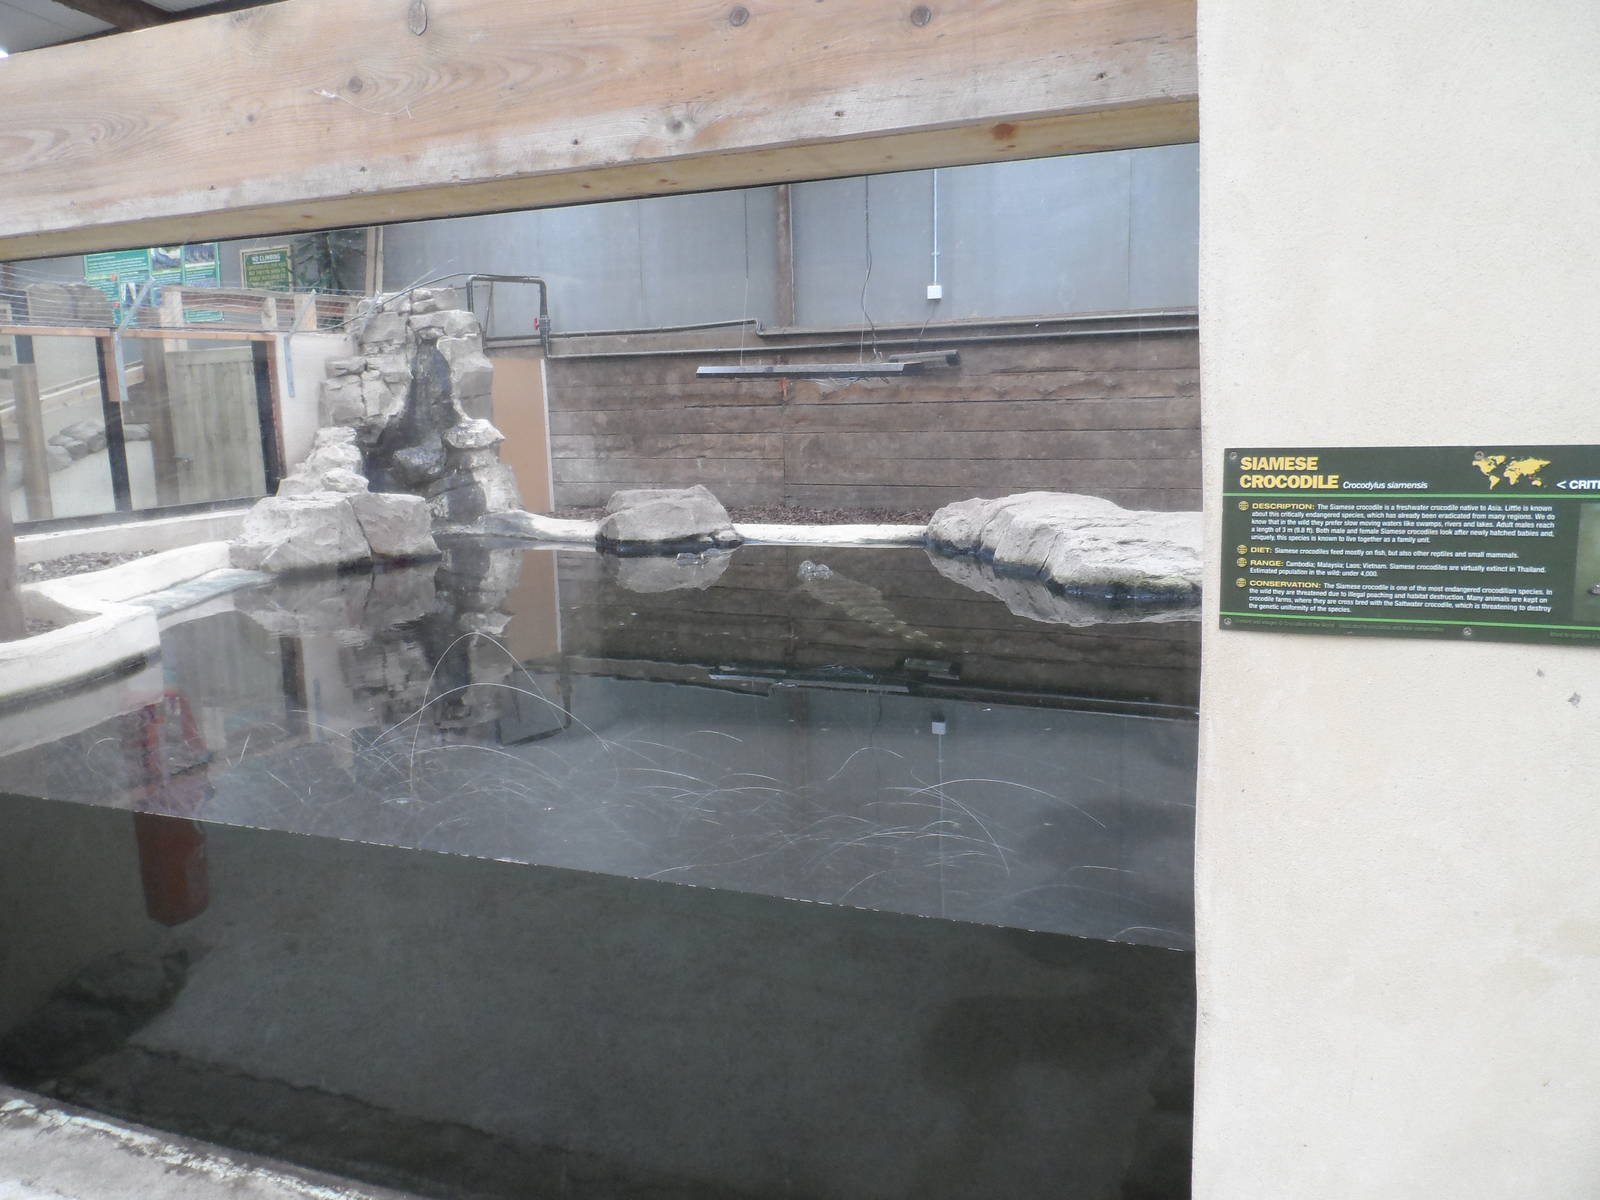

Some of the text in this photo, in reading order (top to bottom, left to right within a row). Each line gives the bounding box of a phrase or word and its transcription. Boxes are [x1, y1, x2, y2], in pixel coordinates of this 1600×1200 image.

[1240, 456, 1319, 471] SIAMESE
[1239, 475, 1428, 490] CROCODILE Crocodylus siamensis
[1280, 512, 1304, 520] critically
[1305, 512, 1341, 520] endangered
[1341, 512, 1365, 520] species,
[1398, 513, 1420, 521] already
[1507, 513, 1533, 522] regions.
[1311, 520, 1324, 528] they
[1325, 520, 1343, 528] prefer
[1359, 520, 1381, 529] moving
[1470, 530, 1489, 538] newly
[1288, 535, 1310, 543] species
[1357, 536, 1382, 544] together
[1397, 537, 1416, 545] family
[1344, 549, 1364, 558] mostly
[1430, 550, 1454, 559] reptiles
[1278, 568, 1308, 577] population
[1460, 564, 1485, 574] virtually
[1249, 581, 1321, 589] CONSERVATION:
[1444, 586, 1481, 596] endangered
[1518, 588, 1544, 597] species.
[1272, 589, 1285, 597] they
[1348, 591, 1366, 600] illegal
[1366, 592, 1394, 600] poaching
[1466, 595, 1484, 603] Many
[1523, 596, 1538, 605] kept
[1259, 604, 1279, 612] genetic
[1280, 604, 1309, 613] uniformity
[1328, 606, 1351, 614] species.
[1313, 598, 1326, 606] they
[1424, 602, 1454, 610] crocodile,
[1481, 603, 1518, 613] threatening
[1527, 605, 1552, 614] destroy
